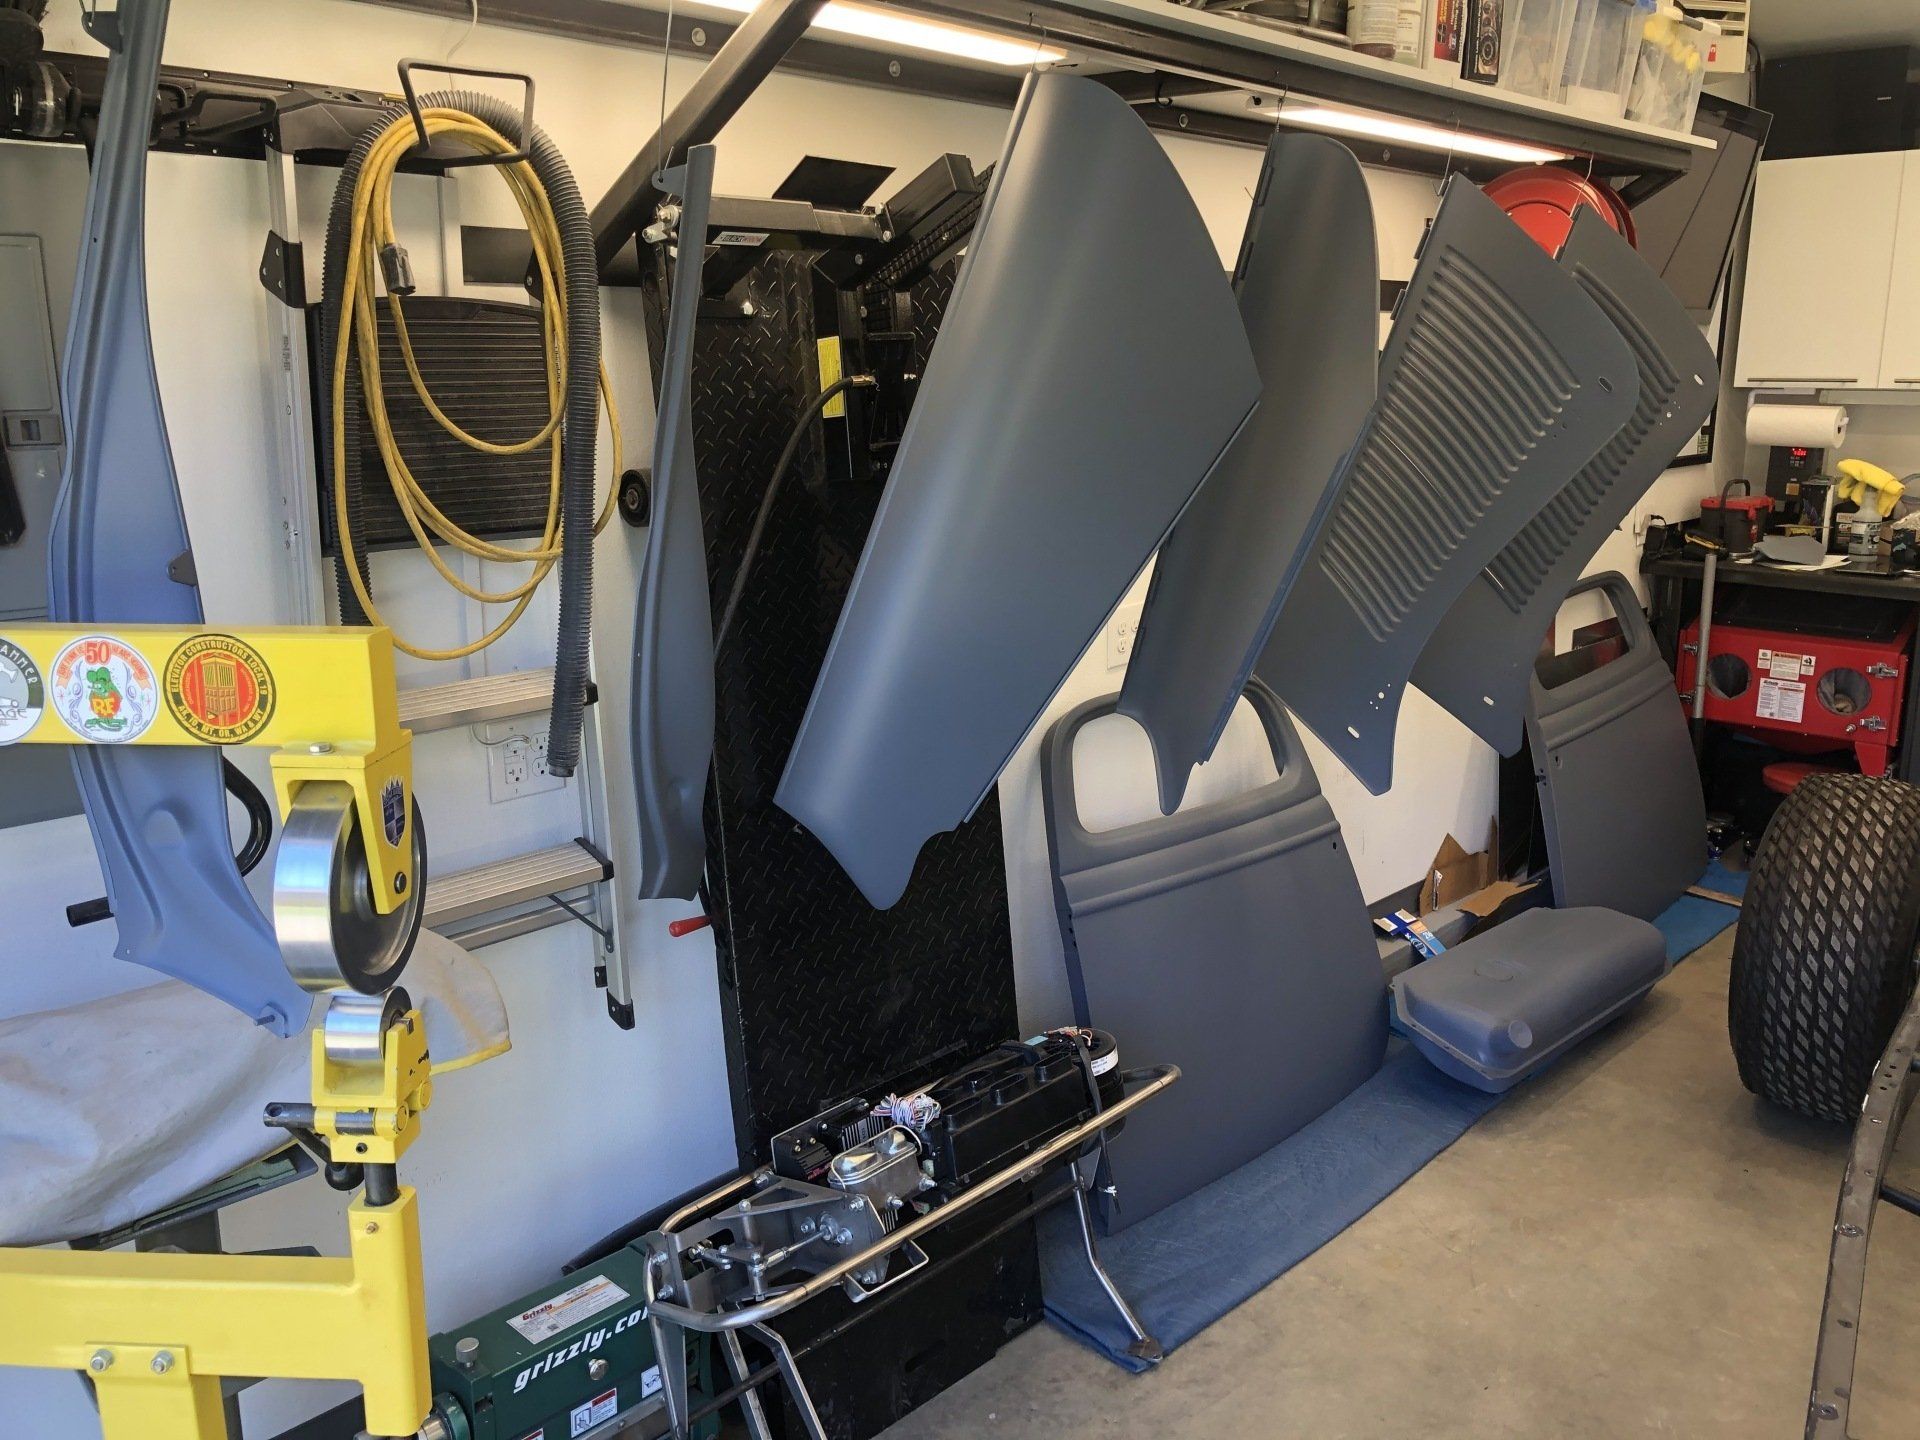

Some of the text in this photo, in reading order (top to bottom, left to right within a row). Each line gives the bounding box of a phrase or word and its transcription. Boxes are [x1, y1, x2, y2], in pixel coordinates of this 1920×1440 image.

[85, 641, 110, 665] 50
[171, 654, 188, 693] ELEVATOR
[186, 640, 248, 660] CONSTRUCTORS
[247, 658, 265, 682] LOCAL
[260, 685, 268, 695] 19
[234, 725, 248, 736] WA
[522, 1303, 553, 1321] Grizzly
